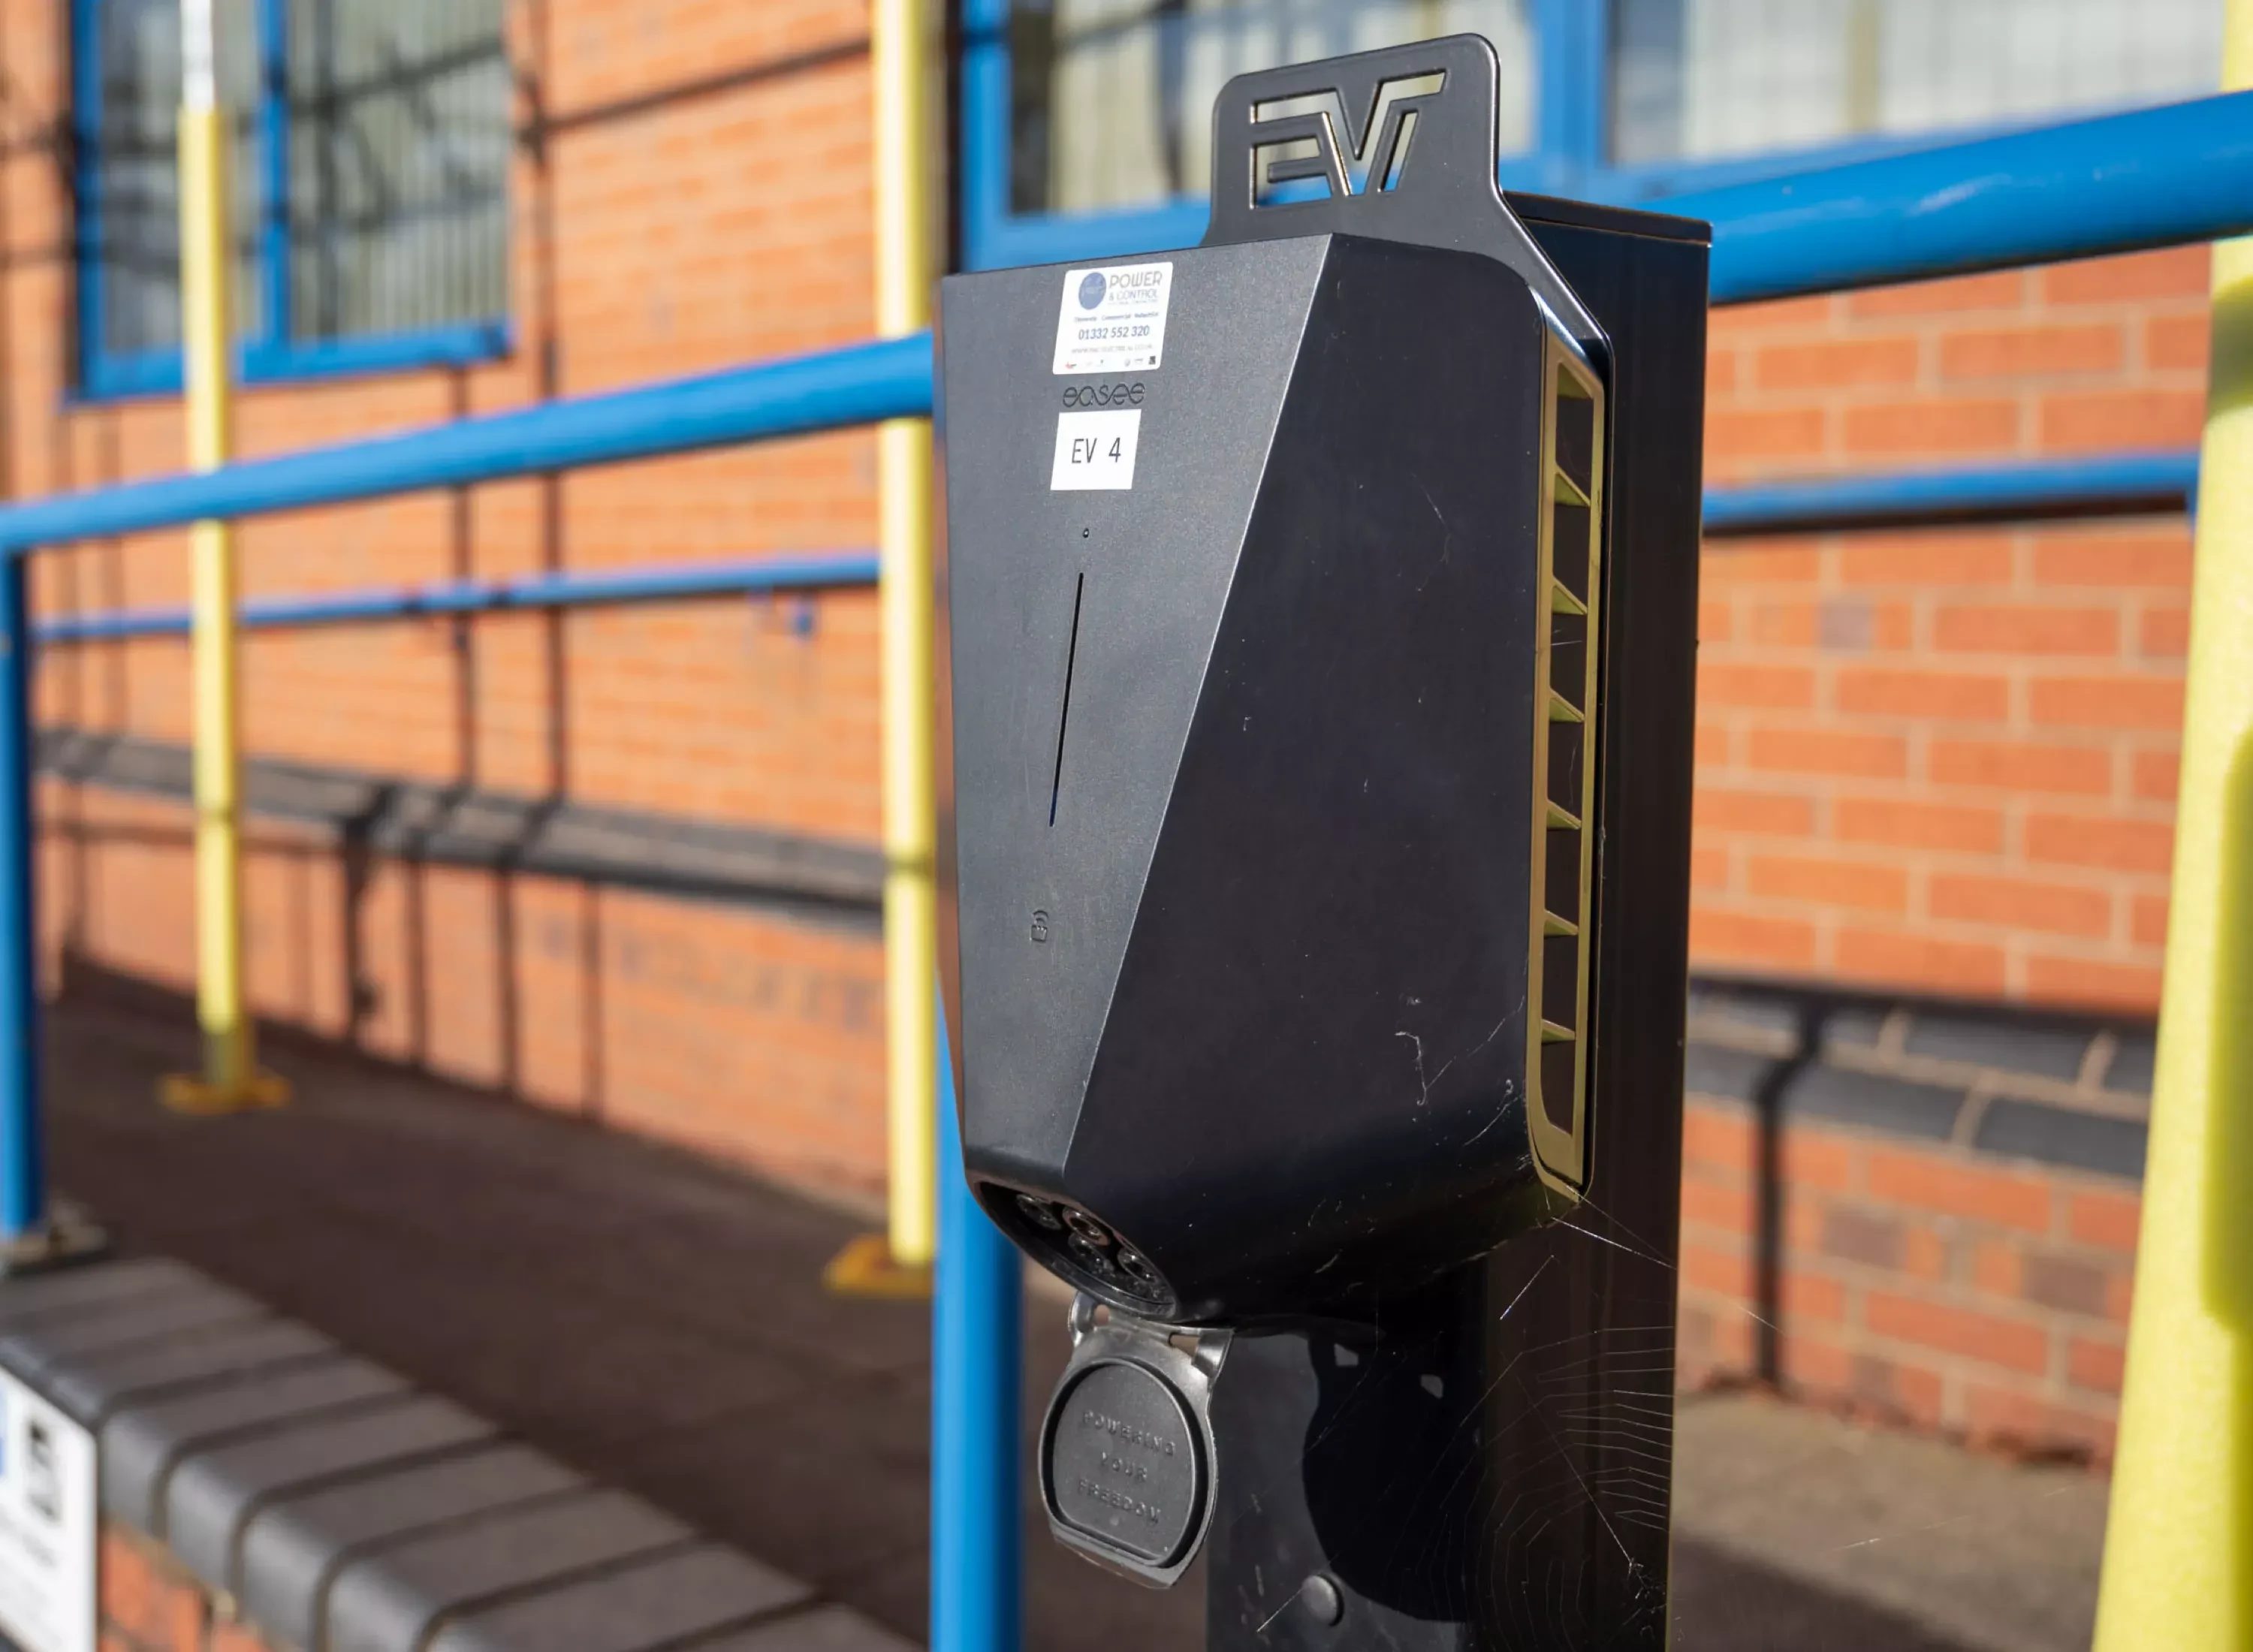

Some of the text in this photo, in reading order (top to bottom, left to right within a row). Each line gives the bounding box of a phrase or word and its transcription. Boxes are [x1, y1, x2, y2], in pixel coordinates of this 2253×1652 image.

[1108, 270, 1163, 289] POWER
[1116, 288, 1159, 300] CONTROL
[1078, 325, 1151, 340] 01332 552 320
[1062, 382, 1145, 408] easee
[1071, 436, 1122, 464] EV 4
[1084, 1409, 1175, 1456] POWERING
[1100, 1450, 1148, 1482] YOUR
[1078, 1478, 1161, 1525] FREEDOM
